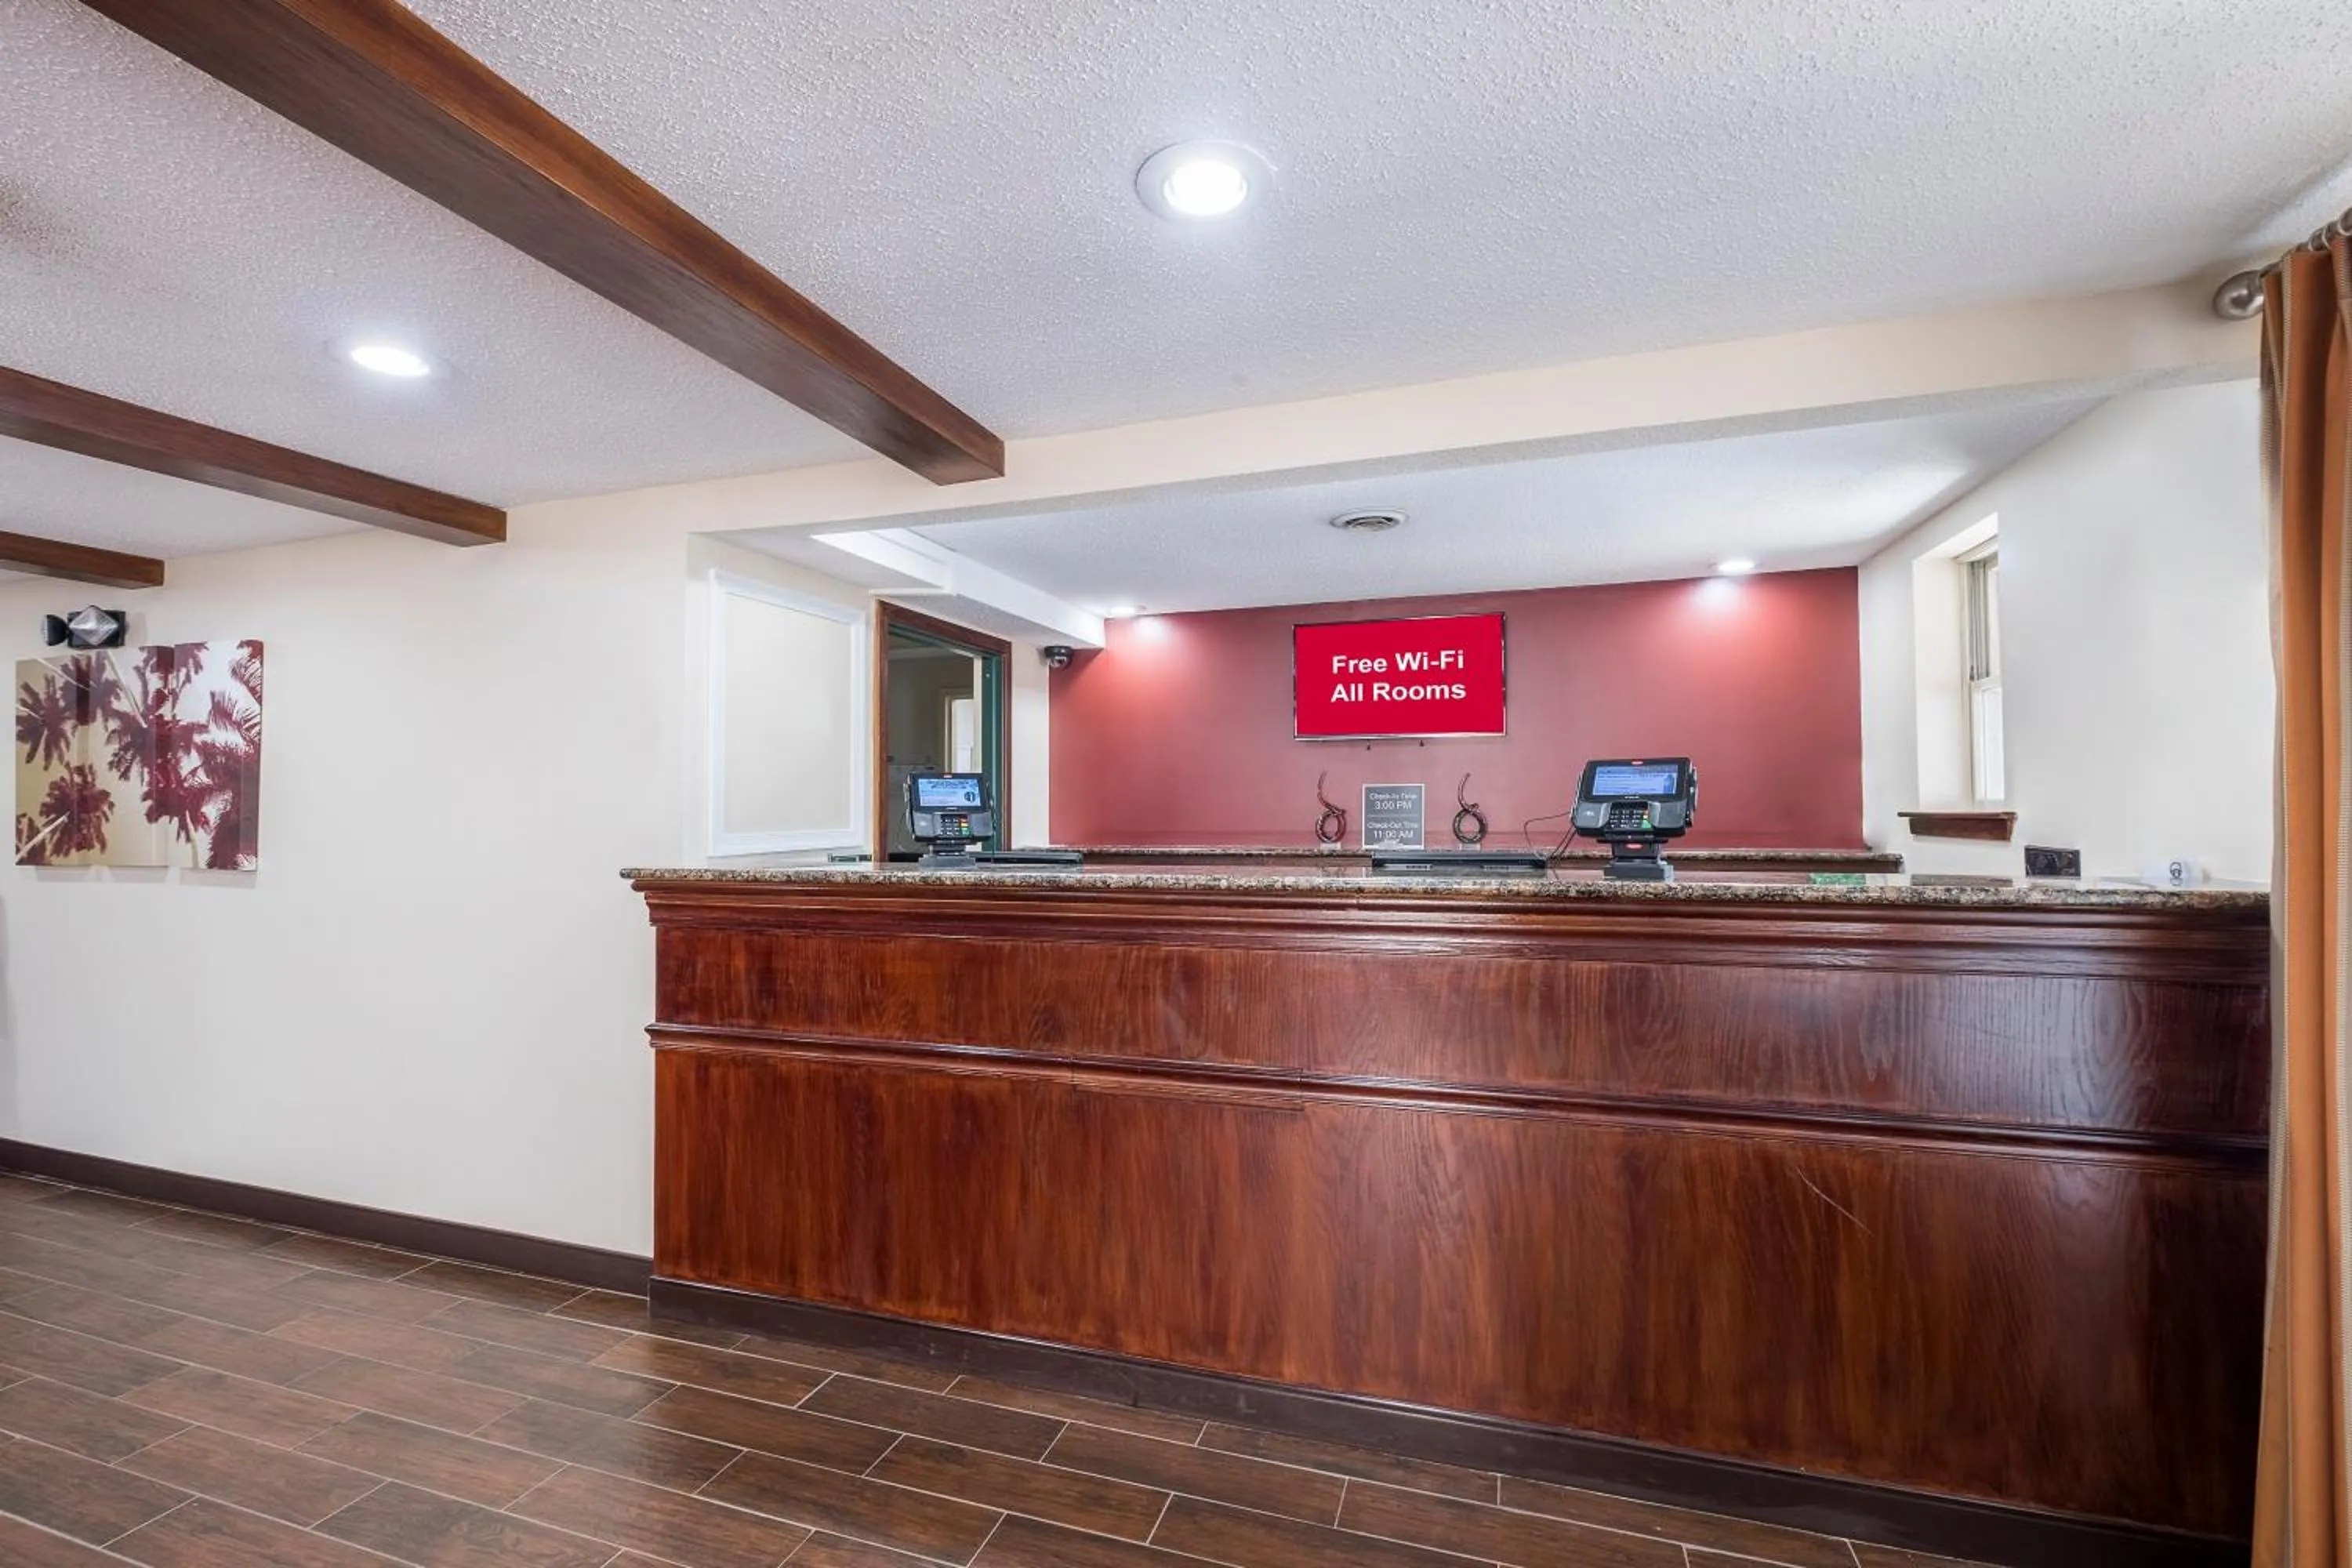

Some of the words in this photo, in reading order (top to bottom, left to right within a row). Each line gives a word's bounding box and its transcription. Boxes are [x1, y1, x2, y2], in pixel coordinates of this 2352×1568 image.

[1332, 655, 1388, 674] Free
[1396, 649, 1464, 671] Wi-Fi
[1331, 683, 1363, 702] All
[1373, 682, 1466, 702] Rooms
[1375, 800, 1394, 809] 3:00
[1396, 800, 1412, 809] PM
[1399, 829, 1414, 838] AM
